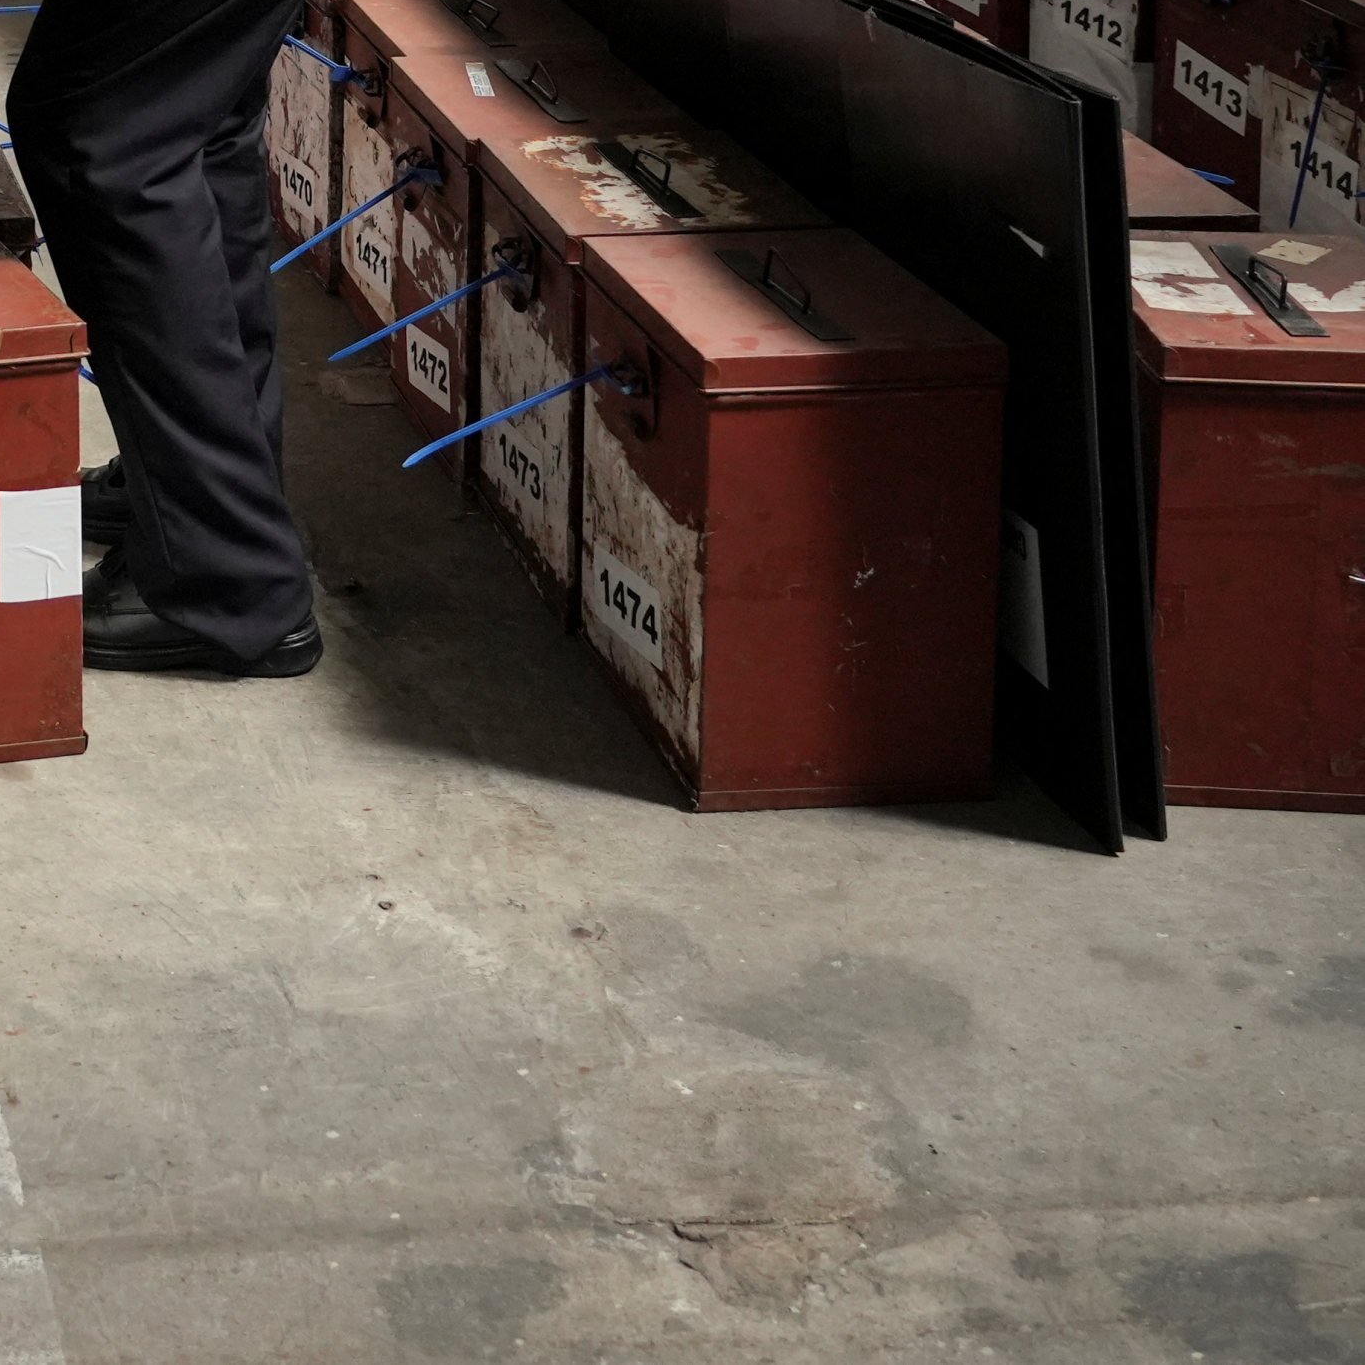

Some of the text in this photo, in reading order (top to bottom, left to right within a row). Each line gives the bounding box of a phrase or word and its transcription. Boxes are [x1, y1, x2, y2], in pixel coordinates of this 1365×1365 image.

[1061, 0, 1122, 47] 1412
[1181, 59, 1242, 118] 1413
[283, 162, 313, 207] 1470
[1290, 140, 1353, 200] 1414
[356, 233, 387, 284] 1471
[411, 341, 448, 395] 1472
[499, 433, 541, 500] 1473
[600, 568, 658, 645] 1474
